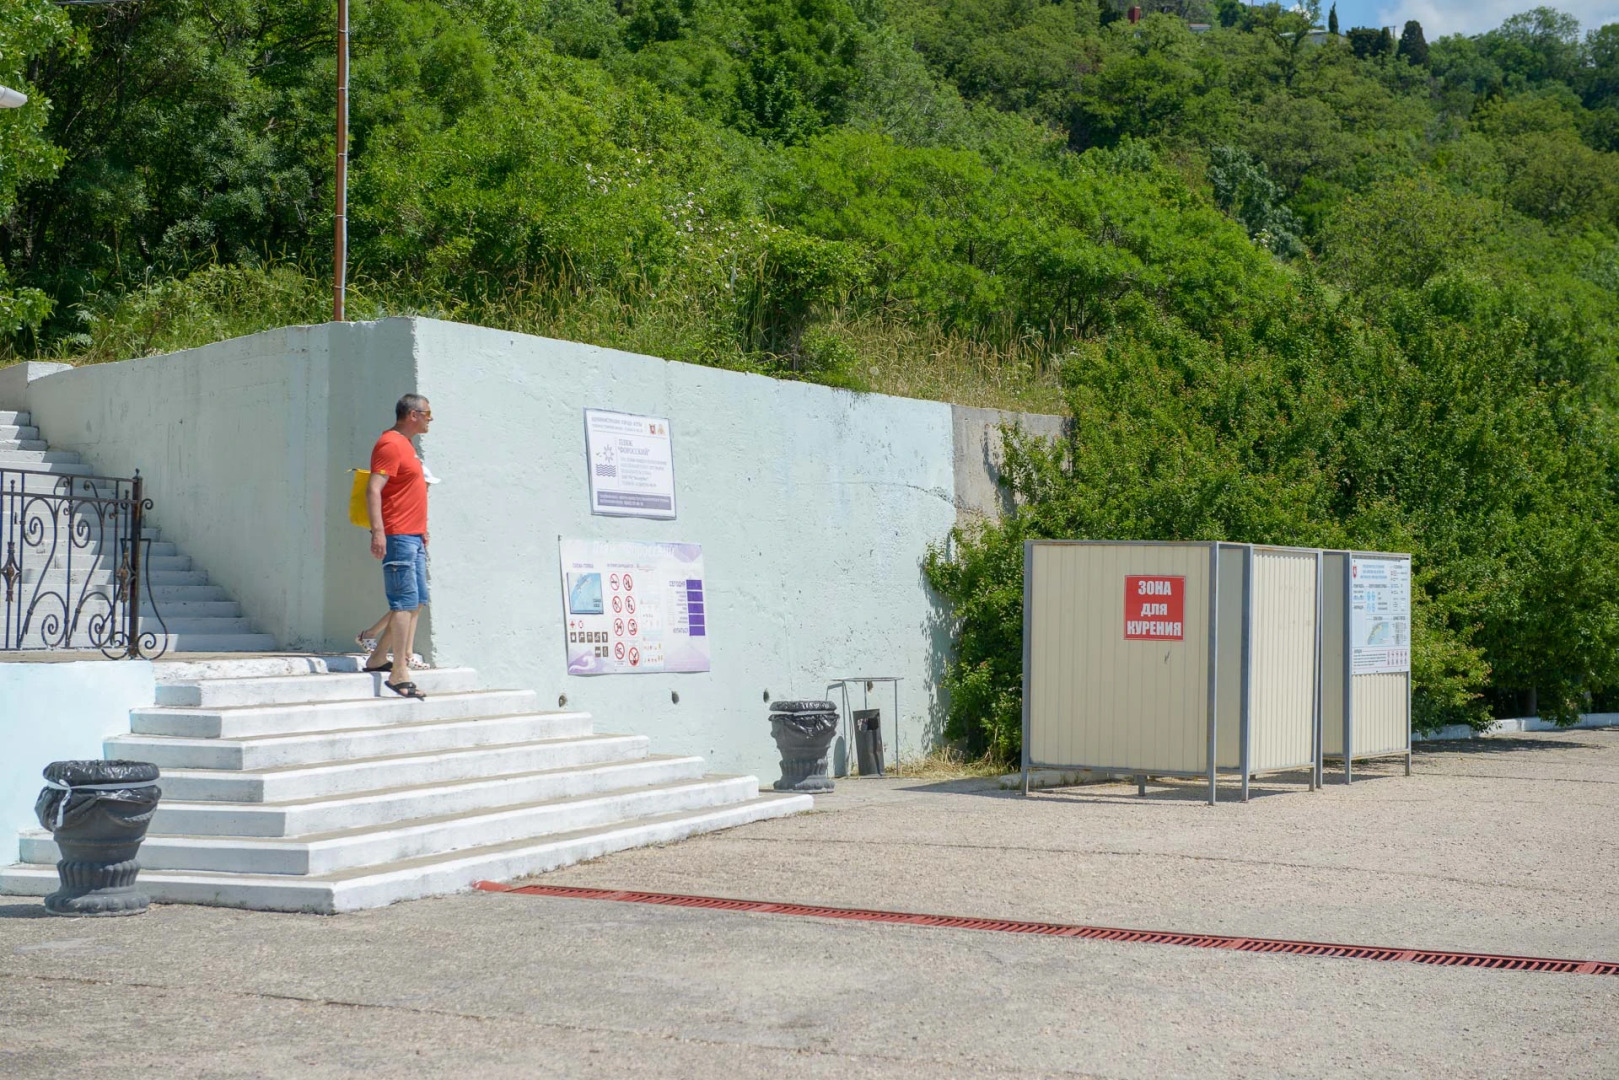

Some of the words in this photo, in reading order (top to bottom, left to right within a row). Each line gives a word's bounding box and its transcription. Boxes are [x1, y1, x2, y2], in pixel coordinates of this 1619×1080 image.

[1138, 580, 1172, 596] ЗОНА
[1141, 603, 1168, 617] ДЛЯ
[1127, 620, 1182, 636] КУРЕНИЯ
